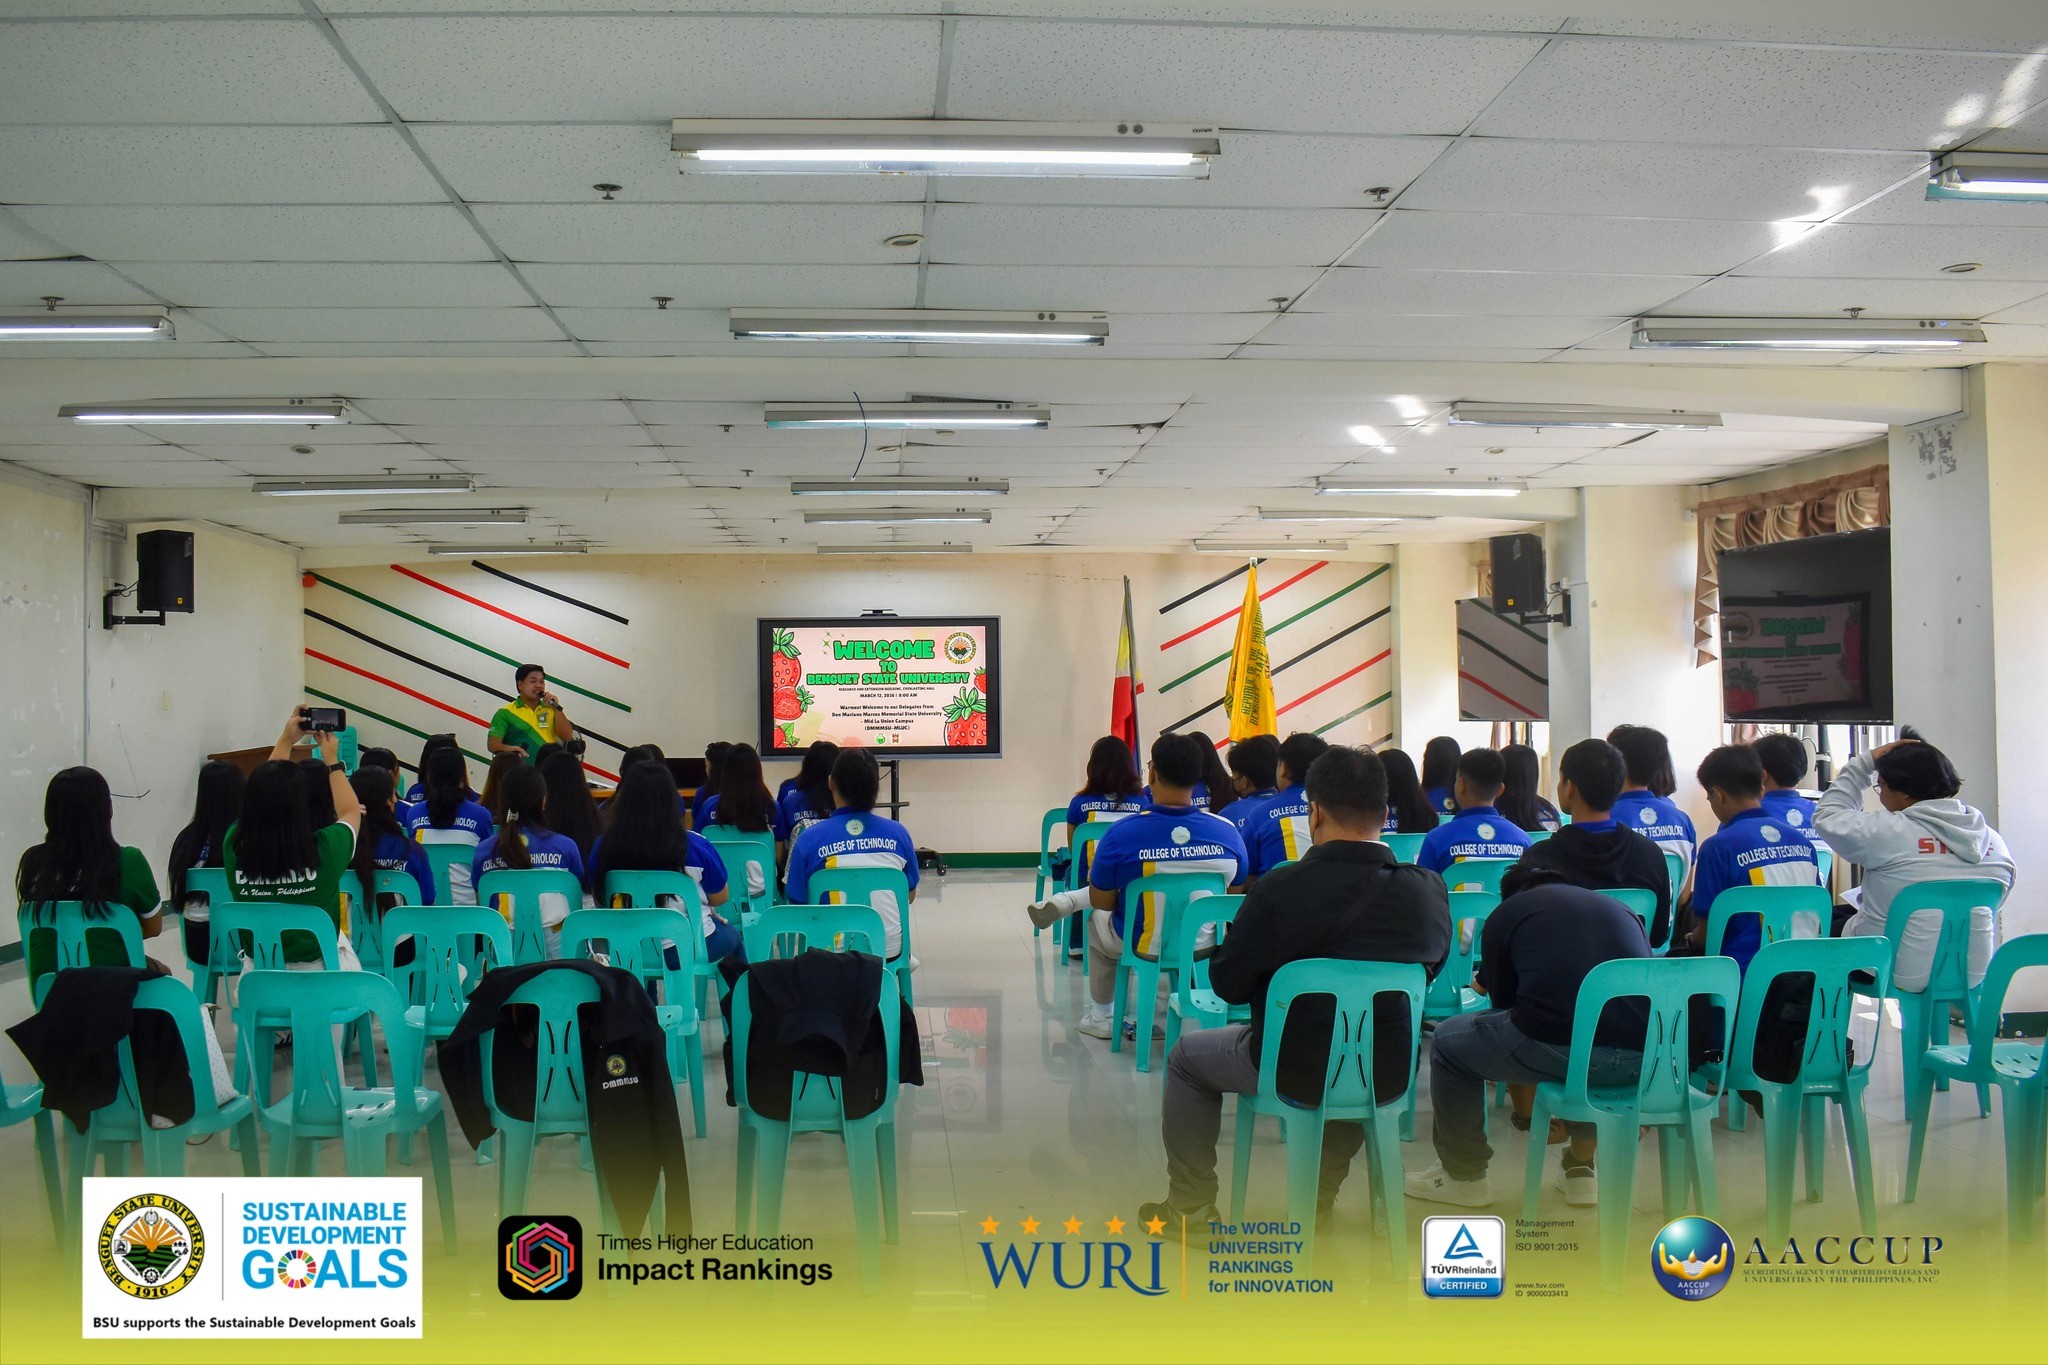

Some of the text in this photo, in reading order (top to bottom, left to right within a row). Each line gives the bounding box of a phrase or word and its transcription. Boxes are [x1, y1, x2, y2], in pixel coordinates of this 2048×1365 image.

[833, 640, 935, 660] WELCOME
[879, 660, 898, 673] TO
[806, 672, 970, 685] BENGUET STATE UNIVERSITY
[1081, 802, 1101, 812] COLLEGE
[1102, 802, 1108, 810] OF
[1269, 806, 1298, 818] COLLEGE
[818, 838, 897, 858] COLLEGE OF TECHNOLOGY
[1139, 844, 1224, 860] COLLEGE OF TECHNOLOGY
[1450, 844, 1524, 856] COLLEGE OF TECHNOLOGY
[530, 853, 562, 864] HNOLOGY
[1737, 848, 1769, 867] COLLEGE
[1768, 846, 1778, 858] OF
[240, 888, 248, 896] La
[277, 886, 316, 896] Philippines
[602, 1077, 639, 1090] DMMMSU
